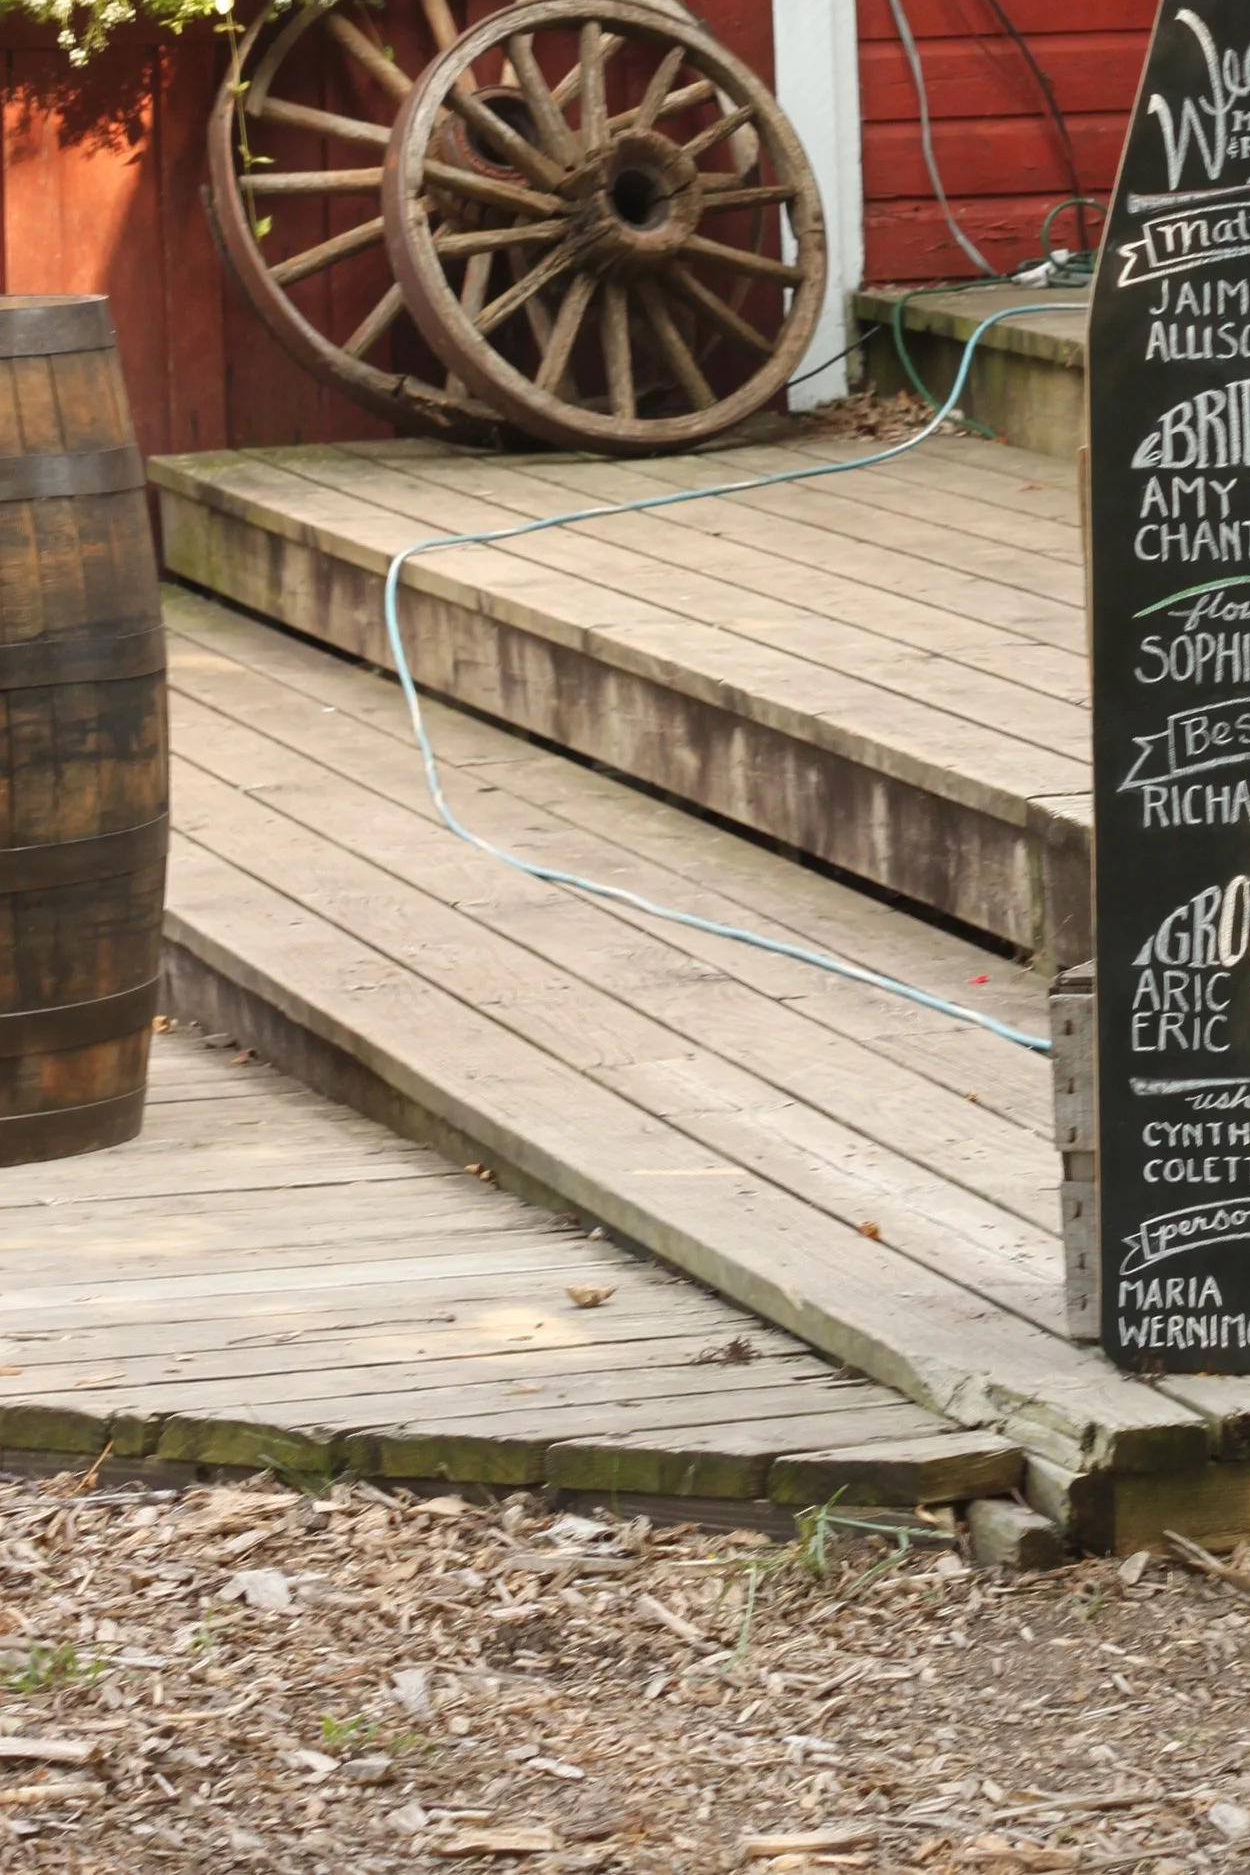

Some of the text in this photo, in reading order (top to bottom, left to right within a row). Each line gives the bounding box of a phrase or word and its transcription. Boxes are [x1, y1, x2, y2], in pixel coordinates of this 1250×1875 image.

[1139, 476, 1238, 518] AMY
[1132, 967, 1232, 1012] ARIC
[1131, 1013, 1230, 1053] ERIC
[1119, 1276, 1224, 1311] MARIA
